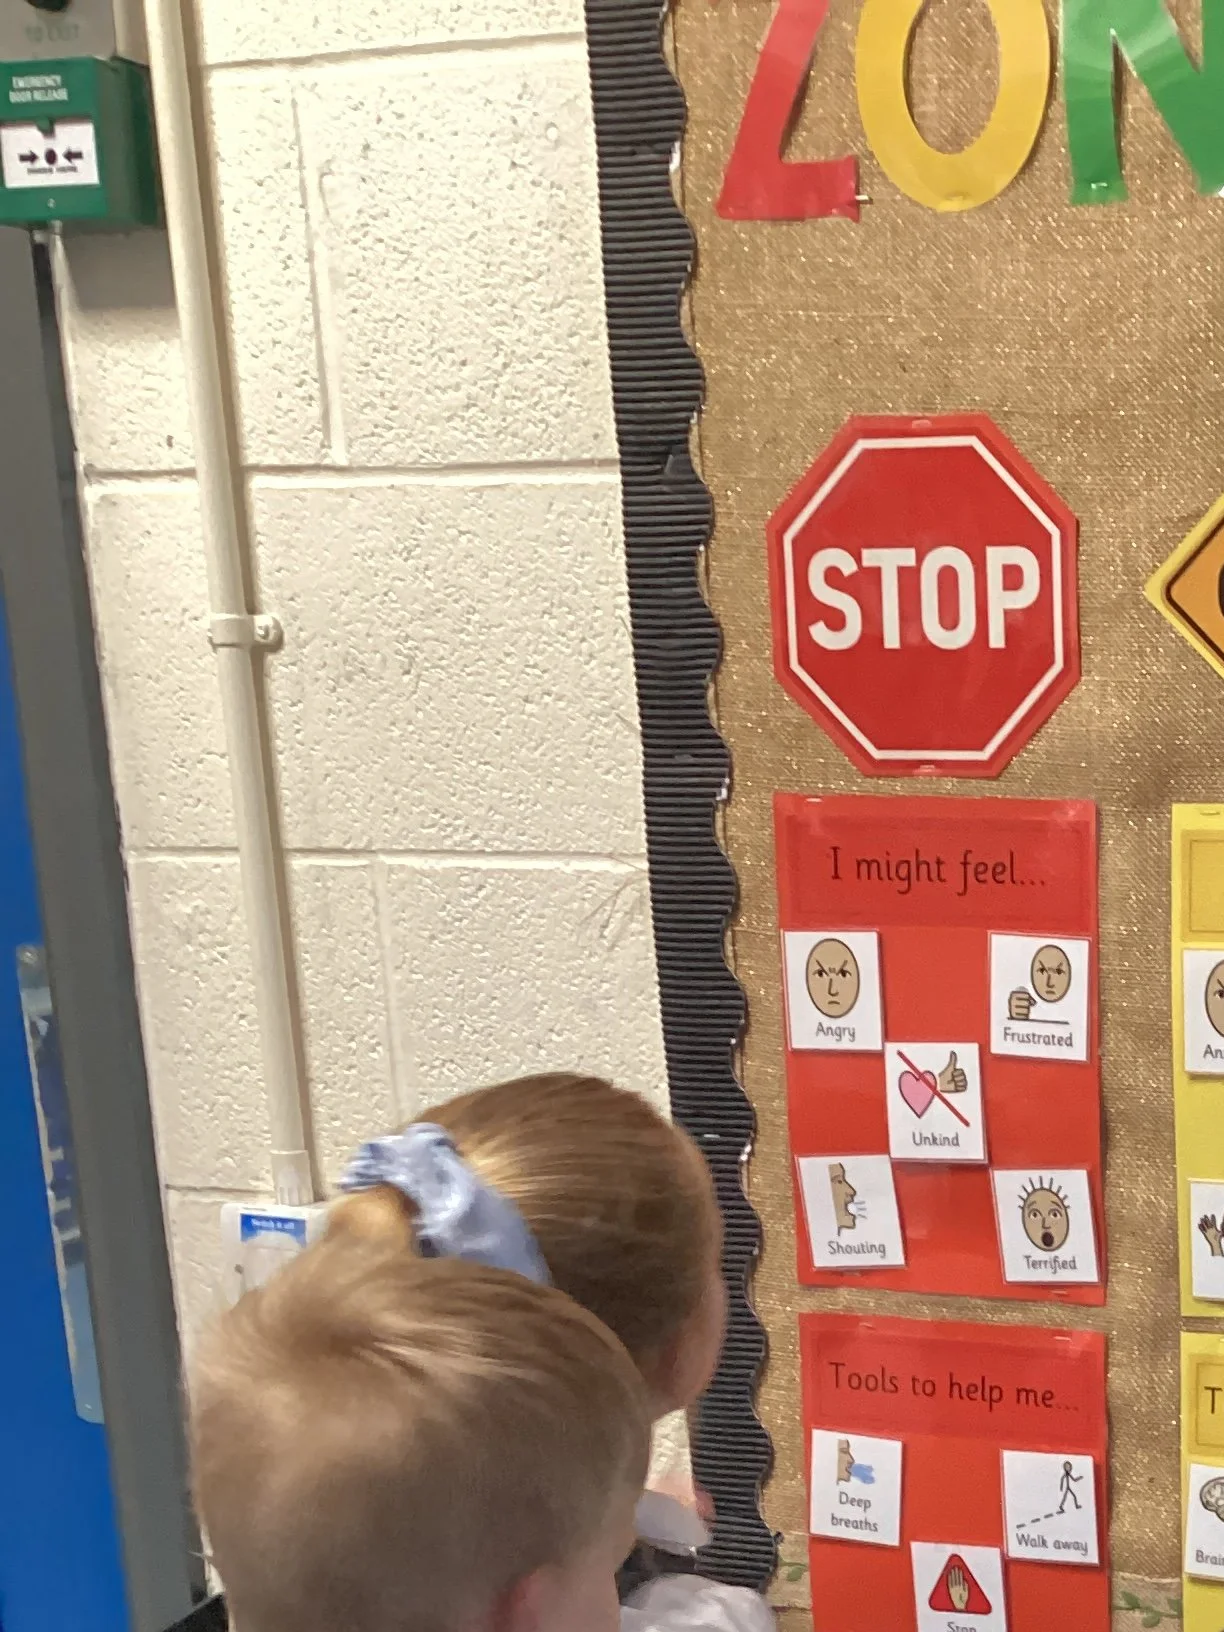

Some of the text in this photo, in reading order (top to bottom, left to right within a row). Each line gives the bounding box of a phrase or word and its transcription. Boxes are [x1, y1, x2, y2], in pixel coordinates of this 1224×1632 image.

[806, 545, 1041, 651] STOP
[831, 846, 1046, 897] I might feel...
[815, 1022, 857, 1043] Angry
[1002, 1026, 1074, 1048] Frustrated
[911, 1131, 960, 1149] Unkind
[827, 1239, 887, 1259] Shouting
[1023, 1254, 1077, 1273] Terrified
[829, 1361, 1080, 1413] Tools to help me...
[838, 1491, 872, 1512] Deep
[830, 1512, 879, 1533] breaths
[1016, 1532, 1089, 1556] Walk away
